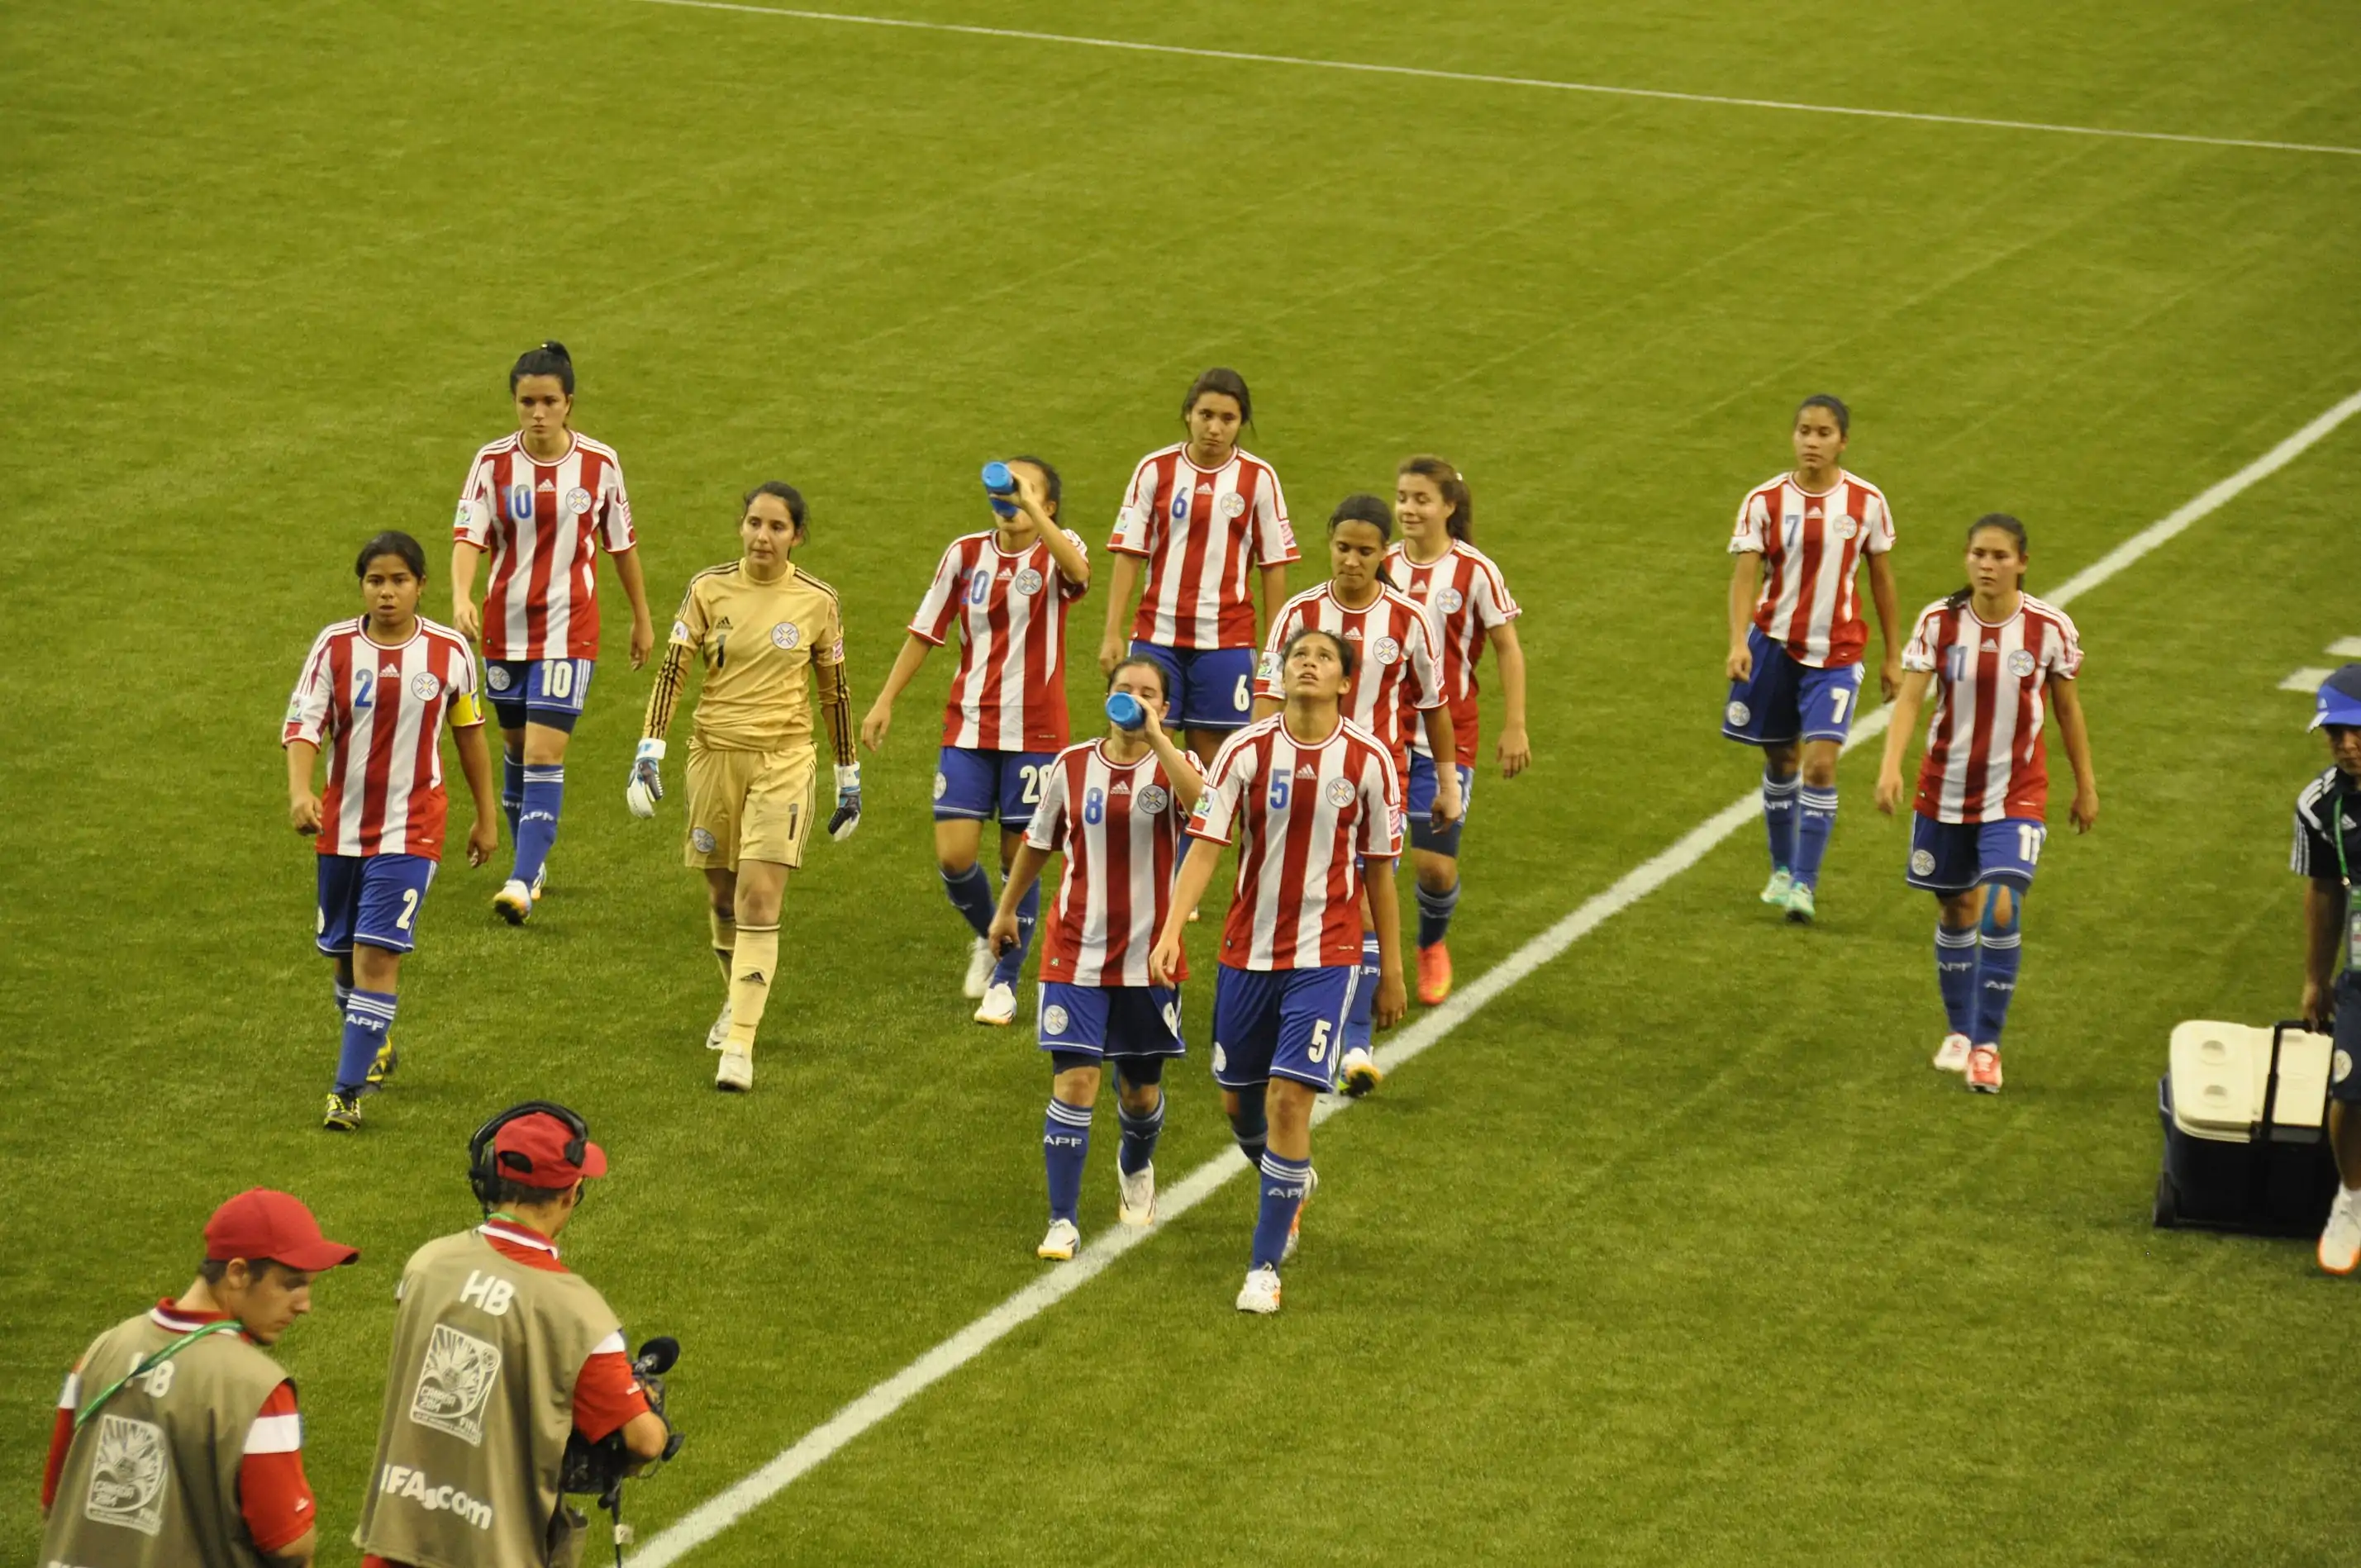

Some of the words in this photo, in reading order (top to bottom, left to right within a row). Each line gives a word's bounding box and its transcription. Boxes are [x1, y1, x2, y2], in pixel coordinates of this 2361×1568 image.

[502, 484, 532, 520] 10
[1172, 487, 1188, 519] 6
[1785, 515, 1802, 547] 7
[716, 634, 726, 668] 1
[355, 668, 374, 708] 2
[542, 660, 573, 698] 10
[1233, 674, 1250, 711] 6
[1830, 687, 1850, 724] 7
[1084, 787, 1103, 824] 8
[1269, 768, 1292, 810] 5
[788, 803, 798, 840] 1
[2018, 824, 2041, 865] 11
[397, 888, 418, 929] 2
[346, 1014, 385, 1032] APF
[1308, 1019, 1332, 1063] 5
[1043, 1134, 1083, 1147] APF
[459, 1269, 516, 1316] HB
